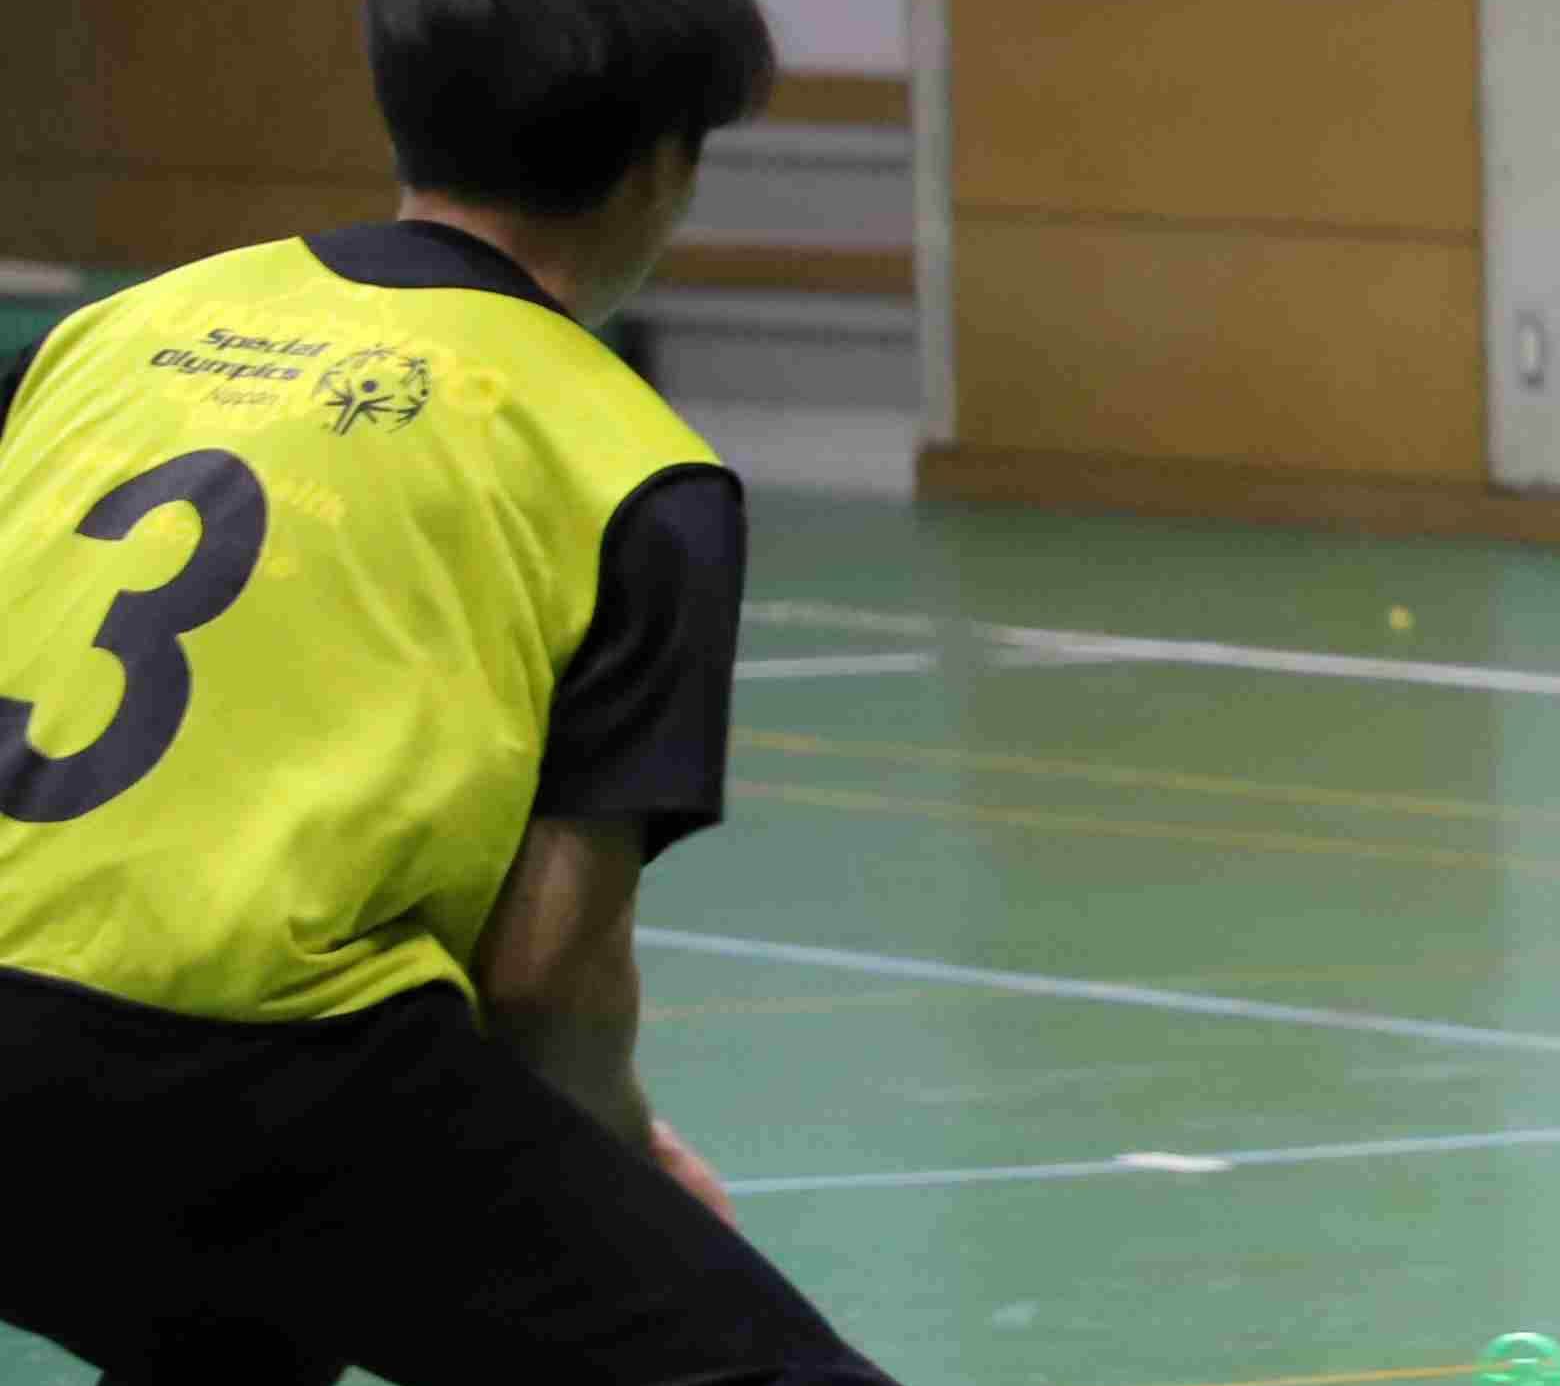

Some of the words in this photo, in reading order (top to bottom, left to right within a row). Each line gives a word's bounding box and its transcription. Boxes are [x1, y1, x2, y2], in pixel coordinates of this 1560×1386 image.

[200, 327, 331, 358] Special
[151, 348, 302, 381] Olympics
[0, 448, 268, 822] 3
